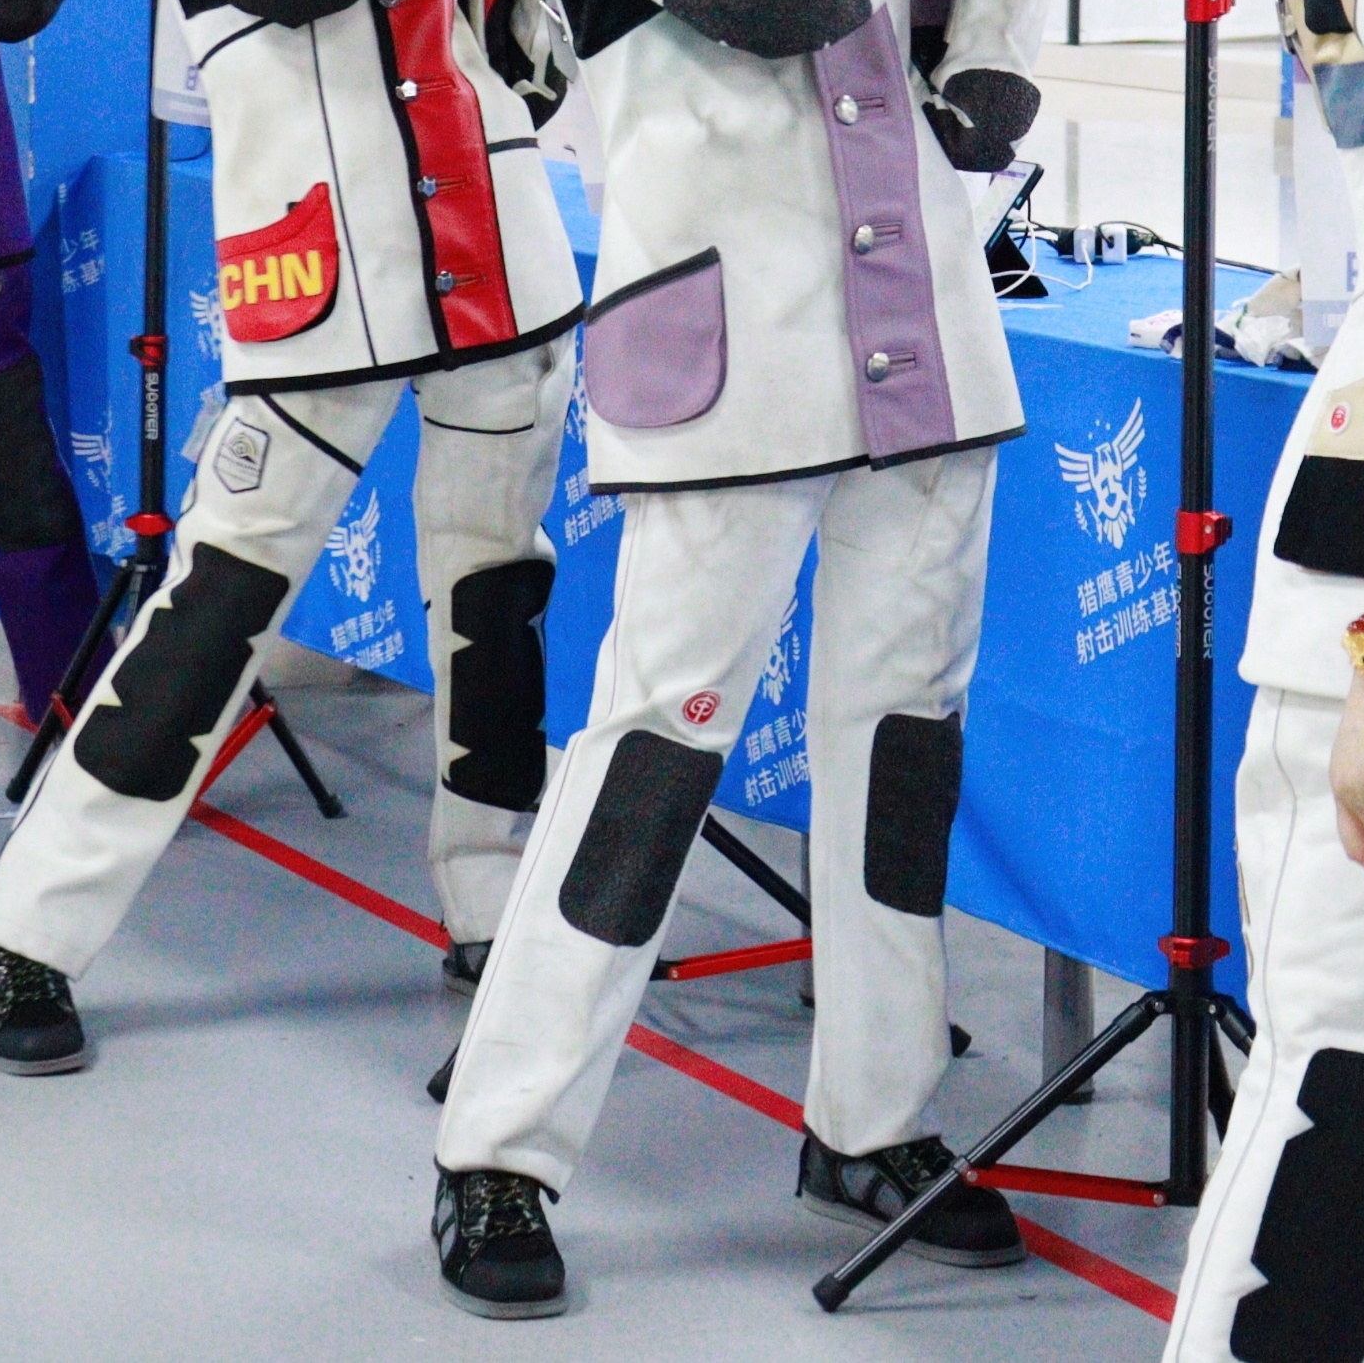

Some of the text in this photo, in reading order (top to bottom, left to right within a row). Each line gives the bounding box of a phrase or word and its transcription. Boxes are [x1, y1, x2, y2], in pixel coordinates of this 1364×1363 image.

[220, 249, 324, 311] CHN
[1077, 540, 1174, 618] 猎鹰青少年
[330, 599, 396, 653] 猎鹰青少年
